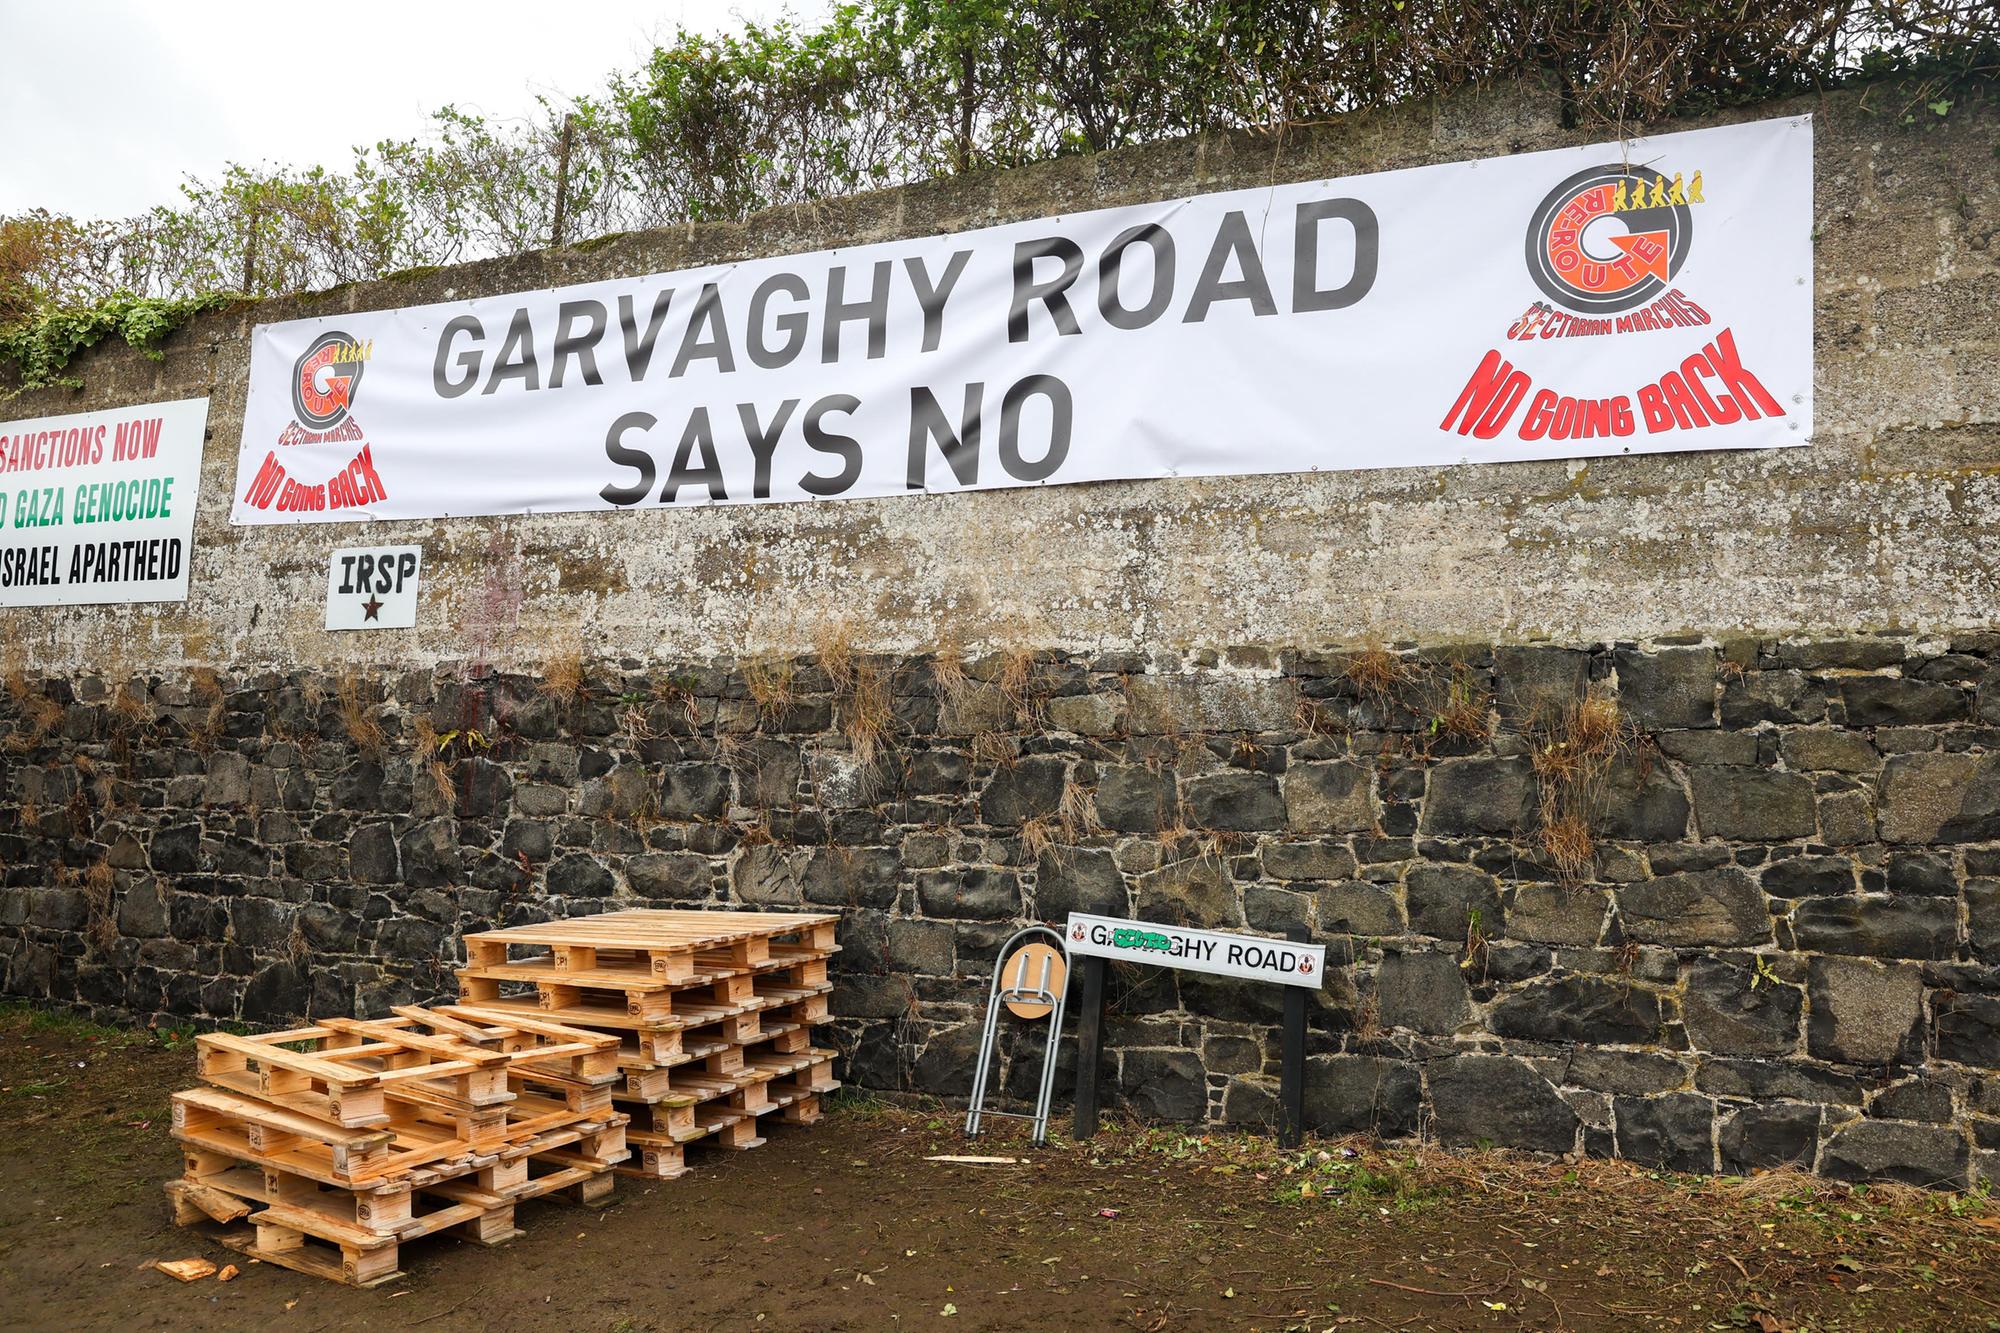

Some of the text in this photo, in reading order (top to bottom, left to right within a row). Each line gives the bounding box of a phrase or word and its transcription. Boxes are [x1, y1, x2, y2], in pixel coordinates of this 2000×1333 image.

[432, 198, 1380, 398] GARVAGHY ROAD
[1507, 288, 1711, 341] SECTARIAN MARCHES
[1440, 327, 1786, 441] NO GOING BACK
[0, 418, 163, 474] SANCTIONS NOW
[600, 374, 1073, 505] SAYS NO
[14, 487, 64, 529] GAZA
[73, 477, 174, 525] GENOCIDE
[244, 442, 388, 512] NO GOING BACK
[68, 538, 181, 584] APARTHEID
[338, 553, 416, 594] IRSP
[1091, 925, 1217, 961] GGHY
[1228, 944, 1296, 972] ROAD
